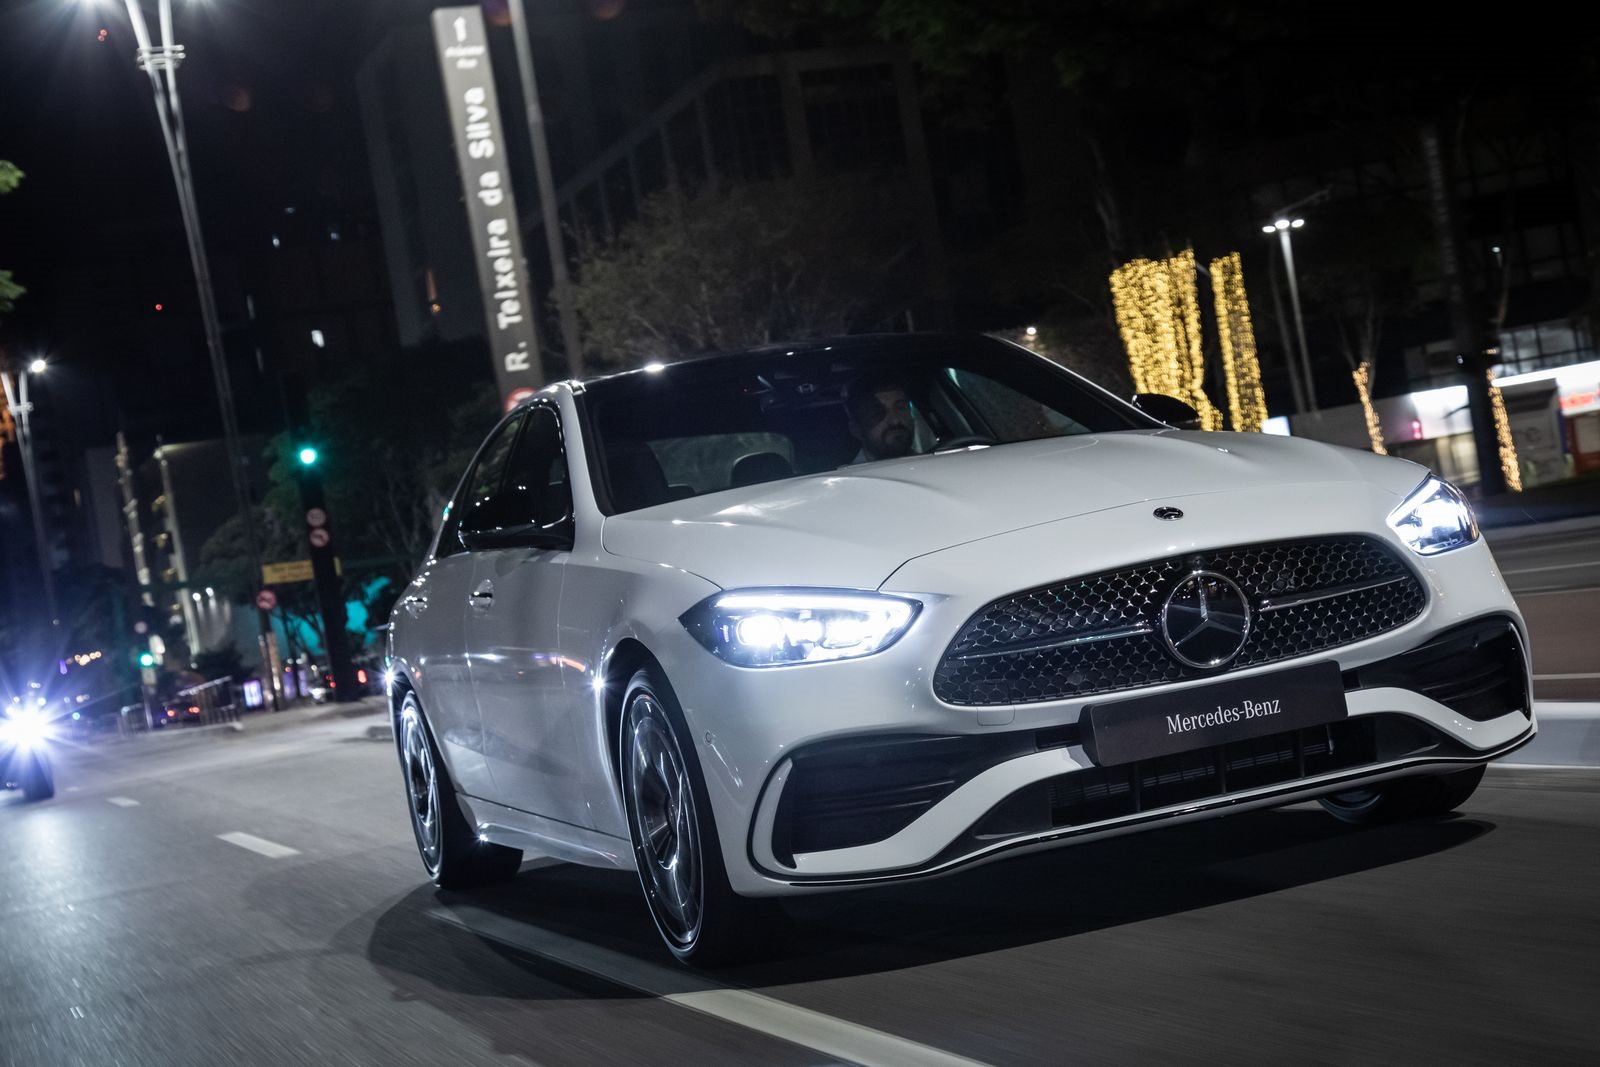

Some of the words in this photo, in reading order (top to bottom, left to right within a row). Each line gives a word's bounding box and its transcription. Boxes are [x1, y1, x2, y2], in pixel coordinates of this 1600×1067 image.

[464, 87, 495, 159] Silva
[477, 171, 503, 206] da
[486, 218, 523, 330] Teixeira
[504, 341, 530, 372] R.
[1166, 699, 1281, 735] Mercedes-Benz
